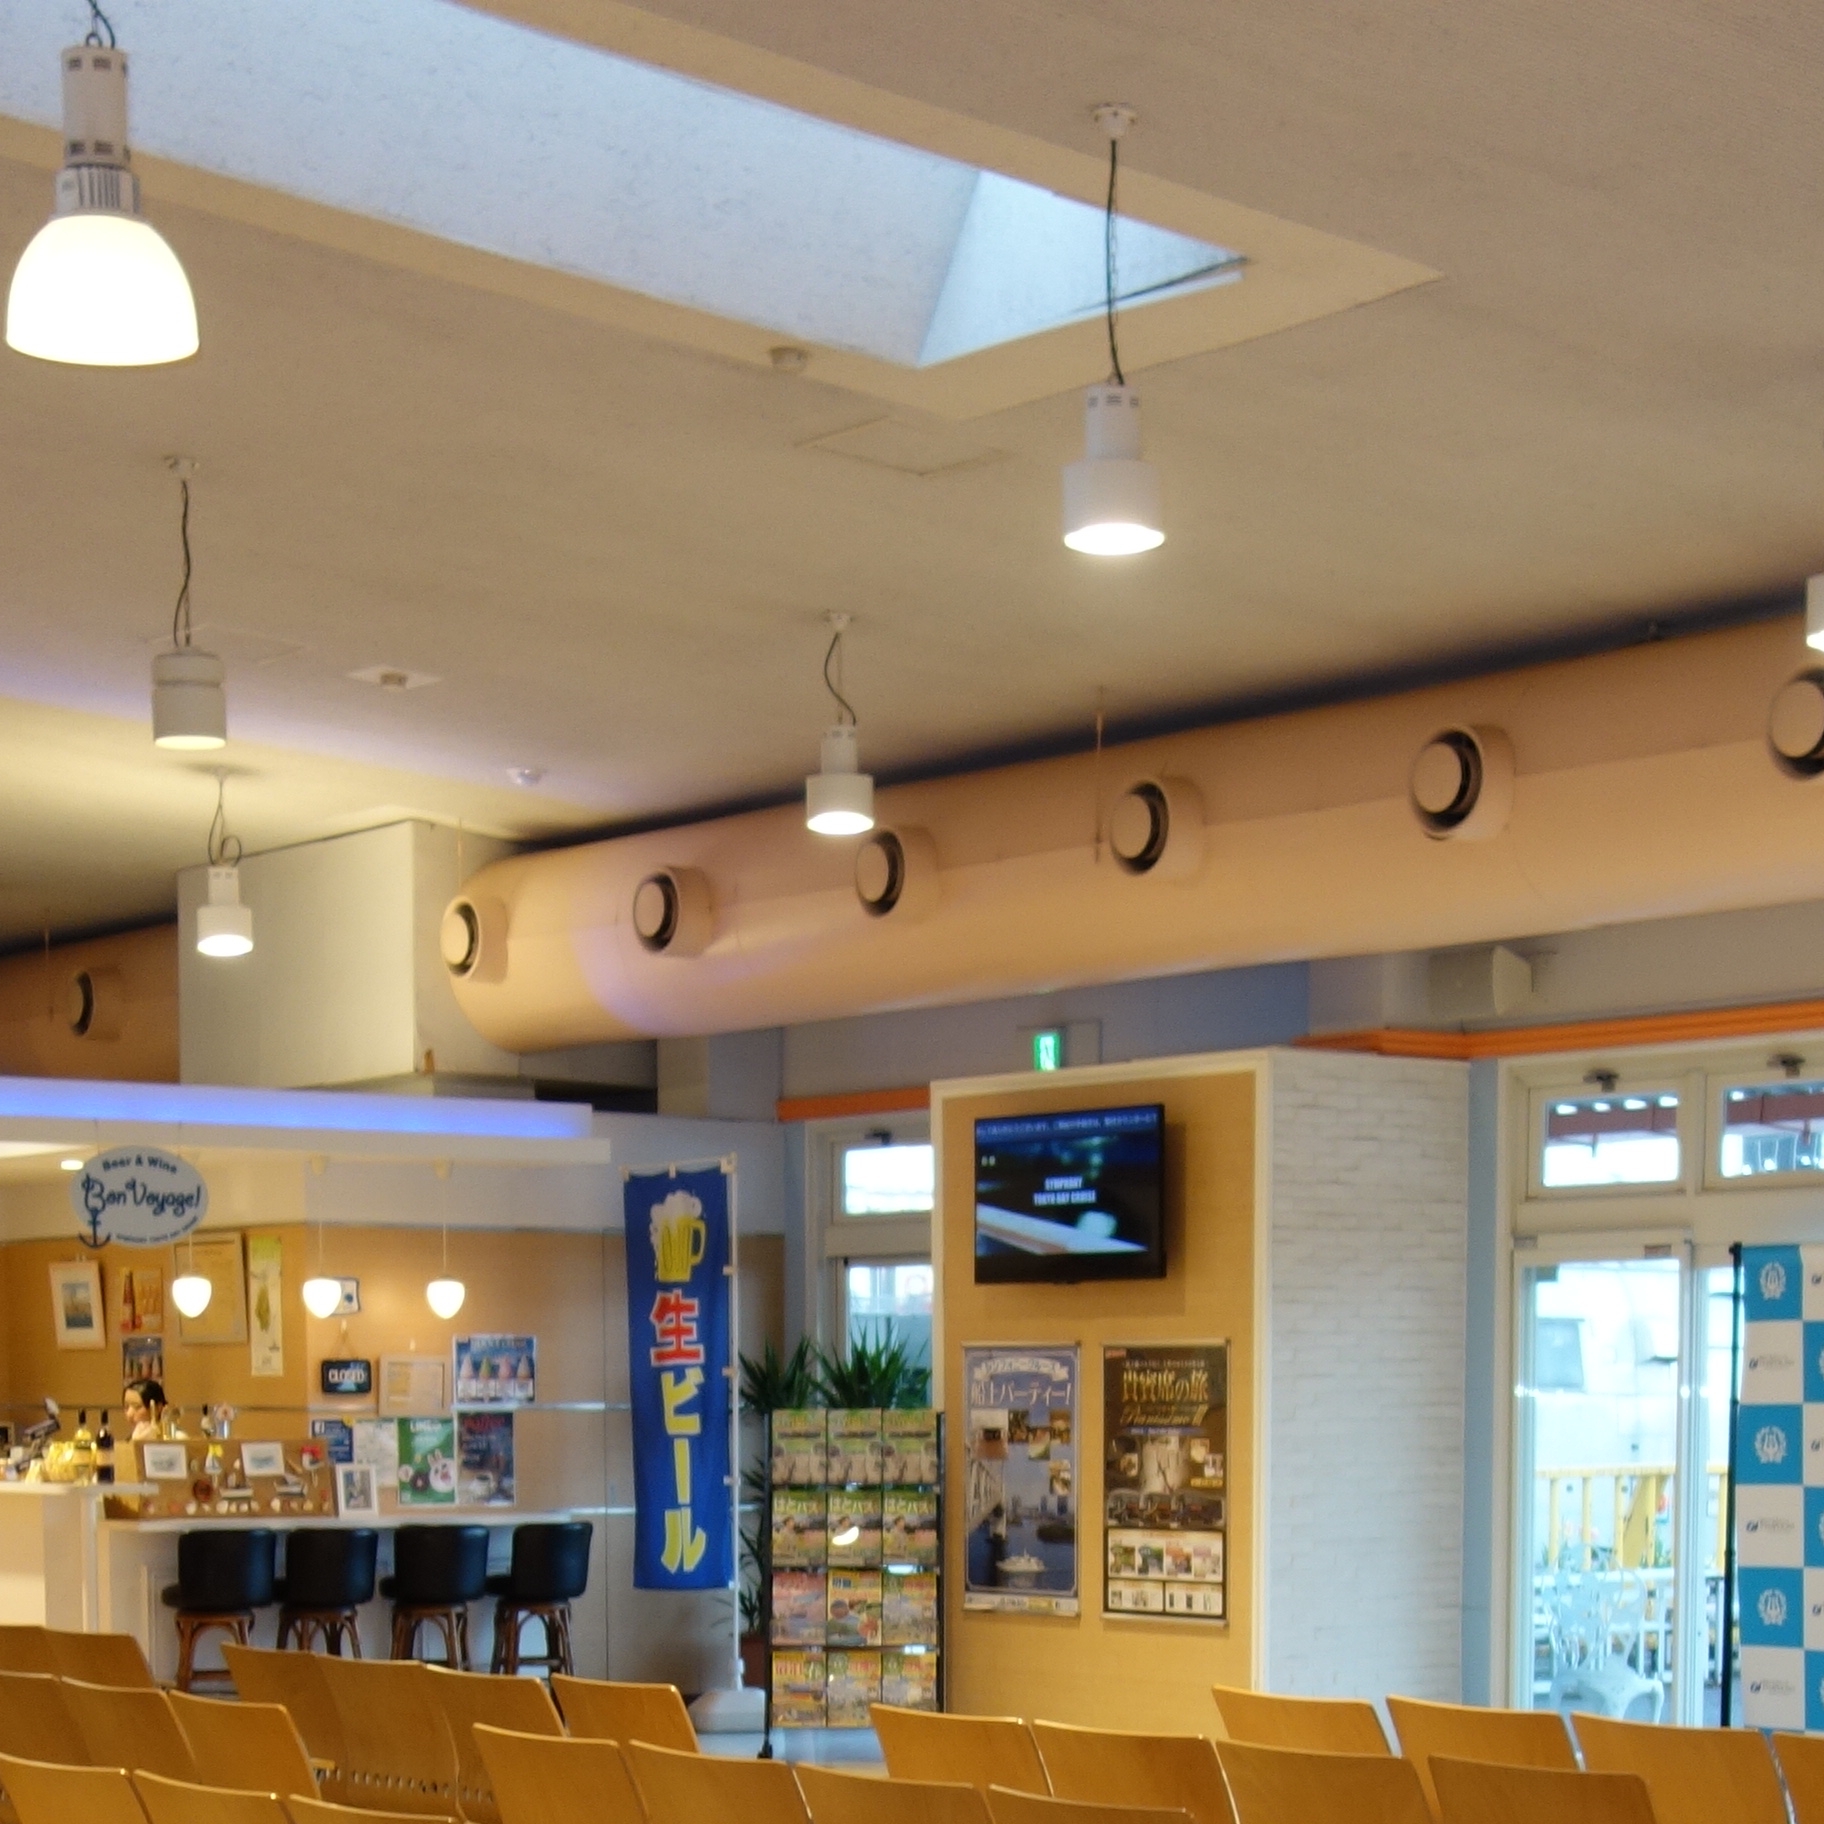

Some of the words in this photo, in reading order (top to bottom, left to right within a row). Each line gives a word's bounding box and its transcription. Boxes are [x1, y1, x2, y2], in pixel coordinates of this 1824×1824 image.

[102, 1156, 131, 1171] Beer
[135, 1154, 143, 1166] &
[147, 1156, 178, 1174] Wine
[81, 1173, 126, 1213] Bon
[125, 1178, 201, 1217] Voyage!
[328, 1368, 365, 1384] CLOSED
[650, 1288, 707, 1574] 生ビール
